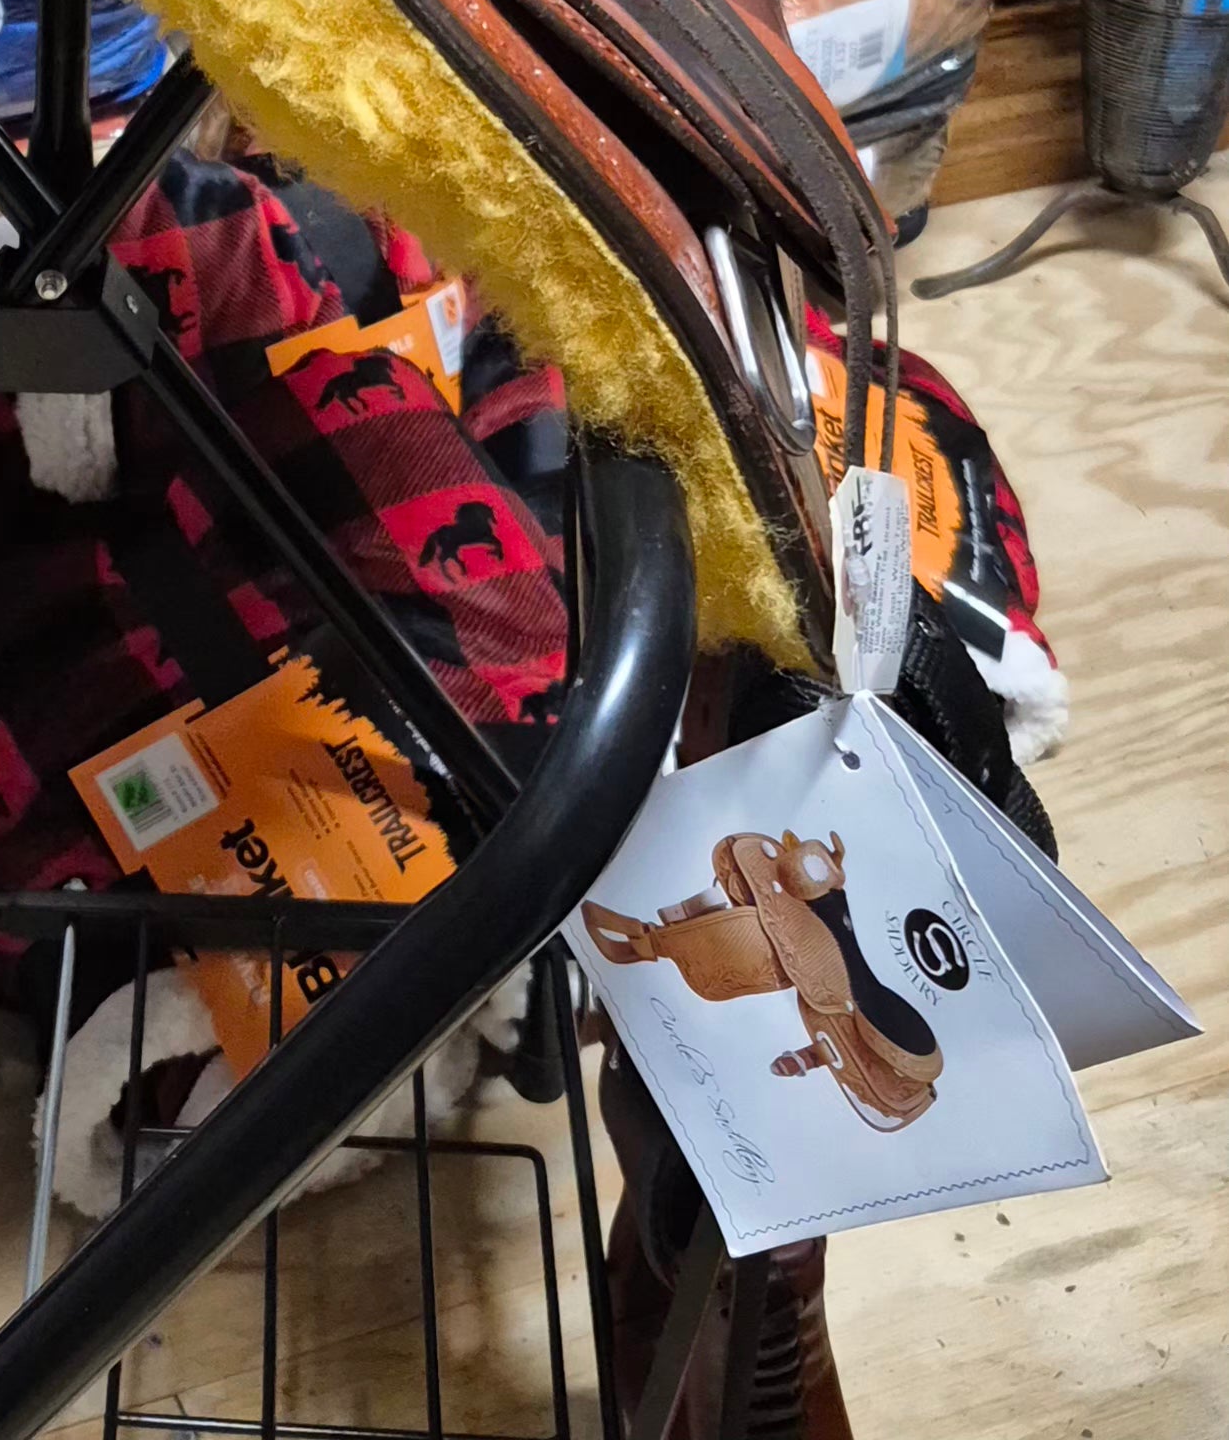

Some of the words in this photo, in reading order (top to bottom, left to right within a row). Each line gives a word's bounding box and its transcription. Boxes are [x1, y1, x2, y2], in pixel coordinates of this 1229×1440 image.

[910, 438, 941, 538] TRAILCREST
[322, 734, 427, 875] TRAILCREST
[941, 900, 995, 983] CIRCLE
